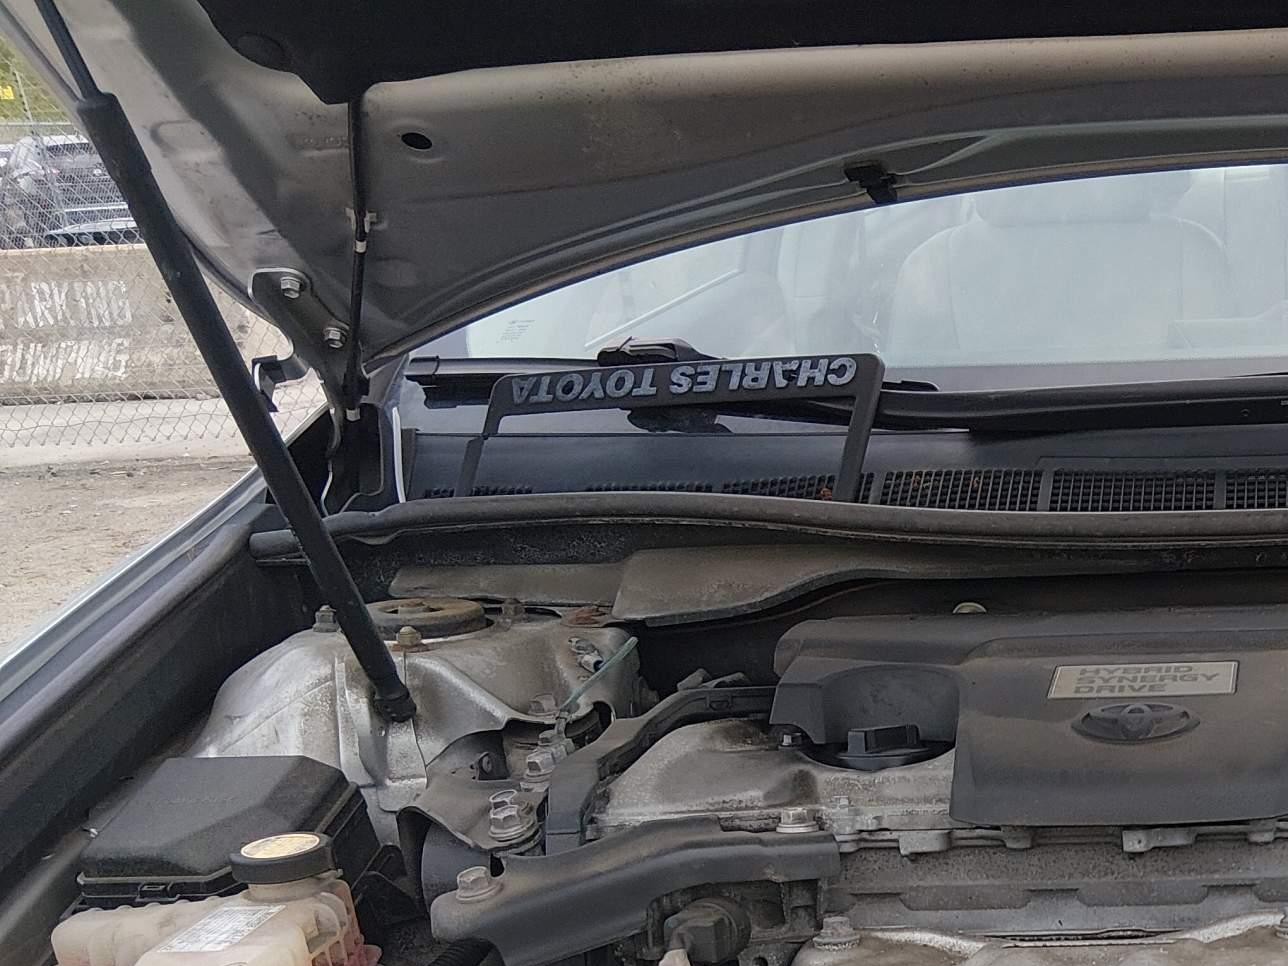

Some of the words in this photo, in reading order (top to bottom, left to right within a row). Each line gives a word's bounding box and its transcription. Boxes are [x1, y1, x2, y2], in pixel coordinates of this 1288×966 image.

[669, 356, 858, 395] CHARLES
[511, 367, 657, 405] TOYOTA
[1079, 665, 1193, 676] HYBRID
[1076, 672, 1220, 685] SYNERGY
[1073, 683, 1166, 695] DRIVE
